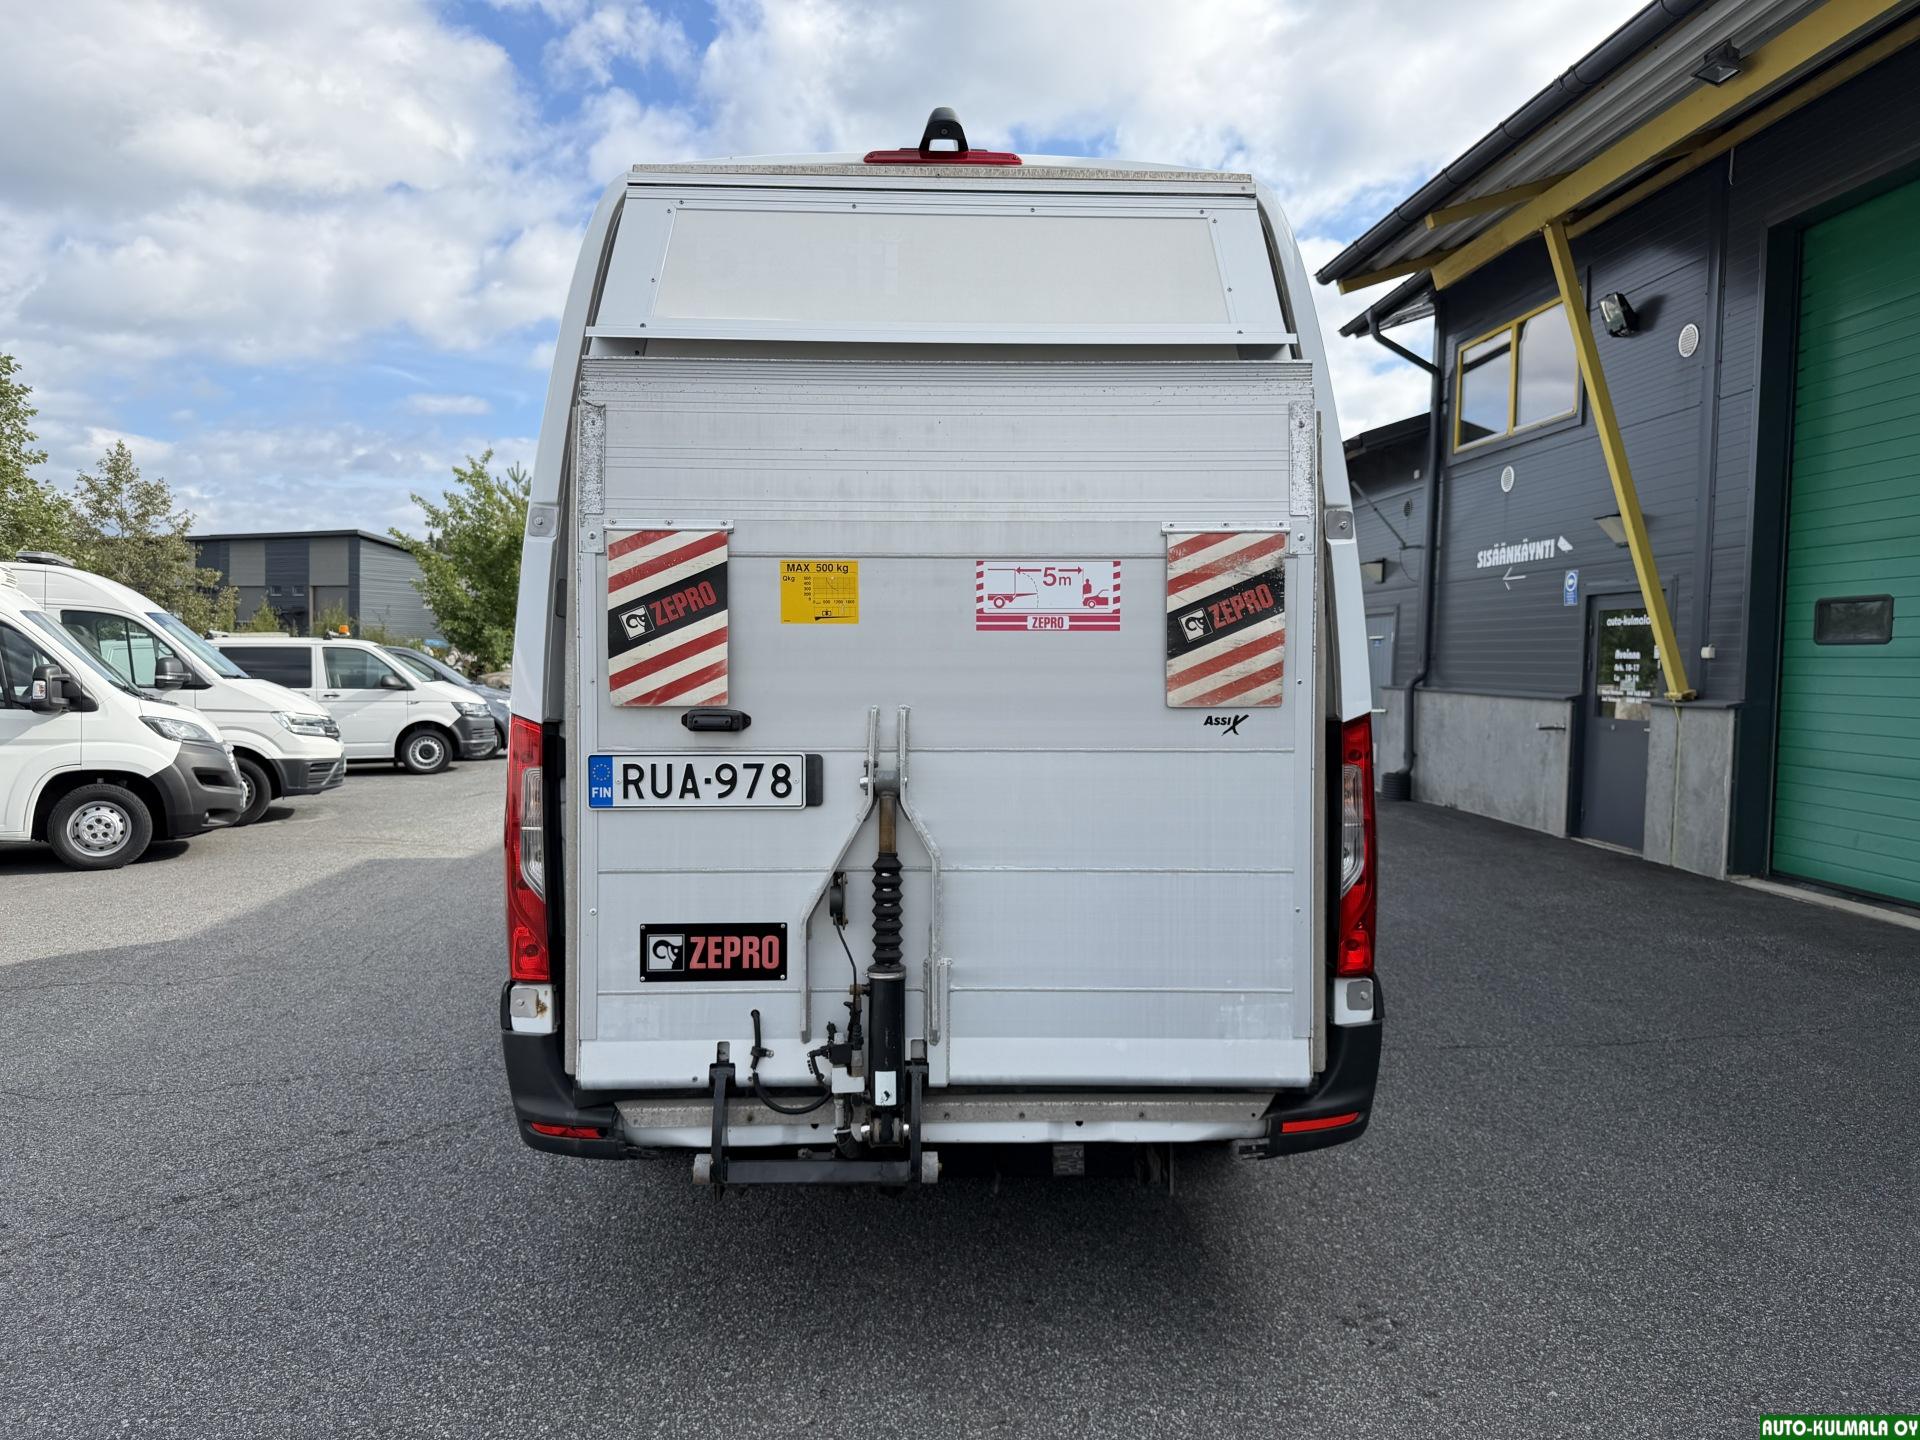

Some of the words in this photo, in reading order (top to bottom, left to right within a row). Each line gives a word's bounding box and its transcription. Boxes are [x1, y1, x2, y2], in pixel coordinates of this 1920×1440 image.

[786, 563, 810, 572] MAX
[816, 563, 834, 572] 500
[837, 563, 849, 574] kg
[1476, 538, 1555, 568] SISÄÄNKÄYNTI
[648, 580, 718, 627] ZEPRO
[1207, 583, 1275, 630] ZEPRO
[1032, 616, 1064, 629] ZEPRO
[591, 787, 612, 798] FIN
[622, 763, 792, 799] RUA-978
[689, 935, 780, 970] ZEPRO
